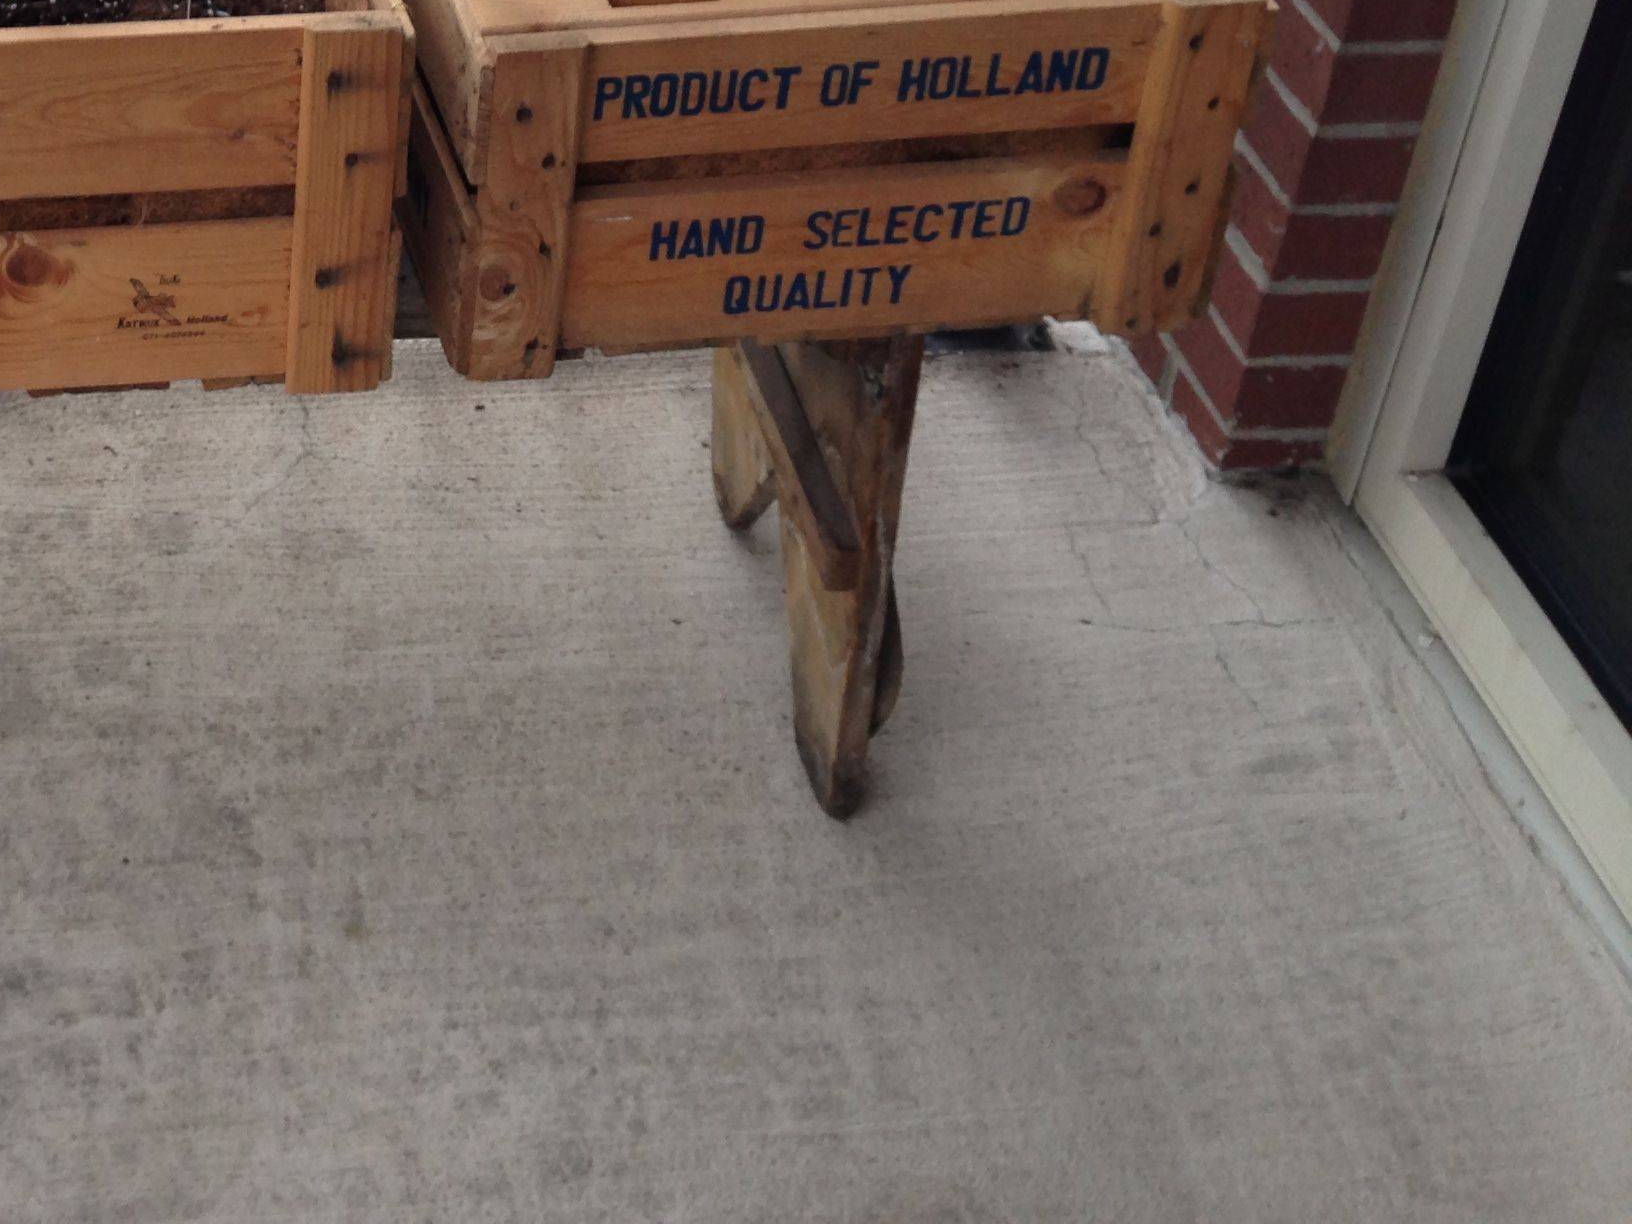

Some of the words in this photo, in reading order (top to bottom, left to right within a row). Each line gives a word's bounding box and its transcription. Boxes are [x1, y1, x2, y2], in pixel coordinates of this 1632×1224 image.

[592, 66, 802, 120] PRODUCT
[820, 60, 880, 107] OF
[897, 47, 1110, 102] HOLLAND
[649, 215, 766, 261] HAND
[803, 196, 1031, 250] SELECTED
[722, 265, 912, 315] QUALITY
